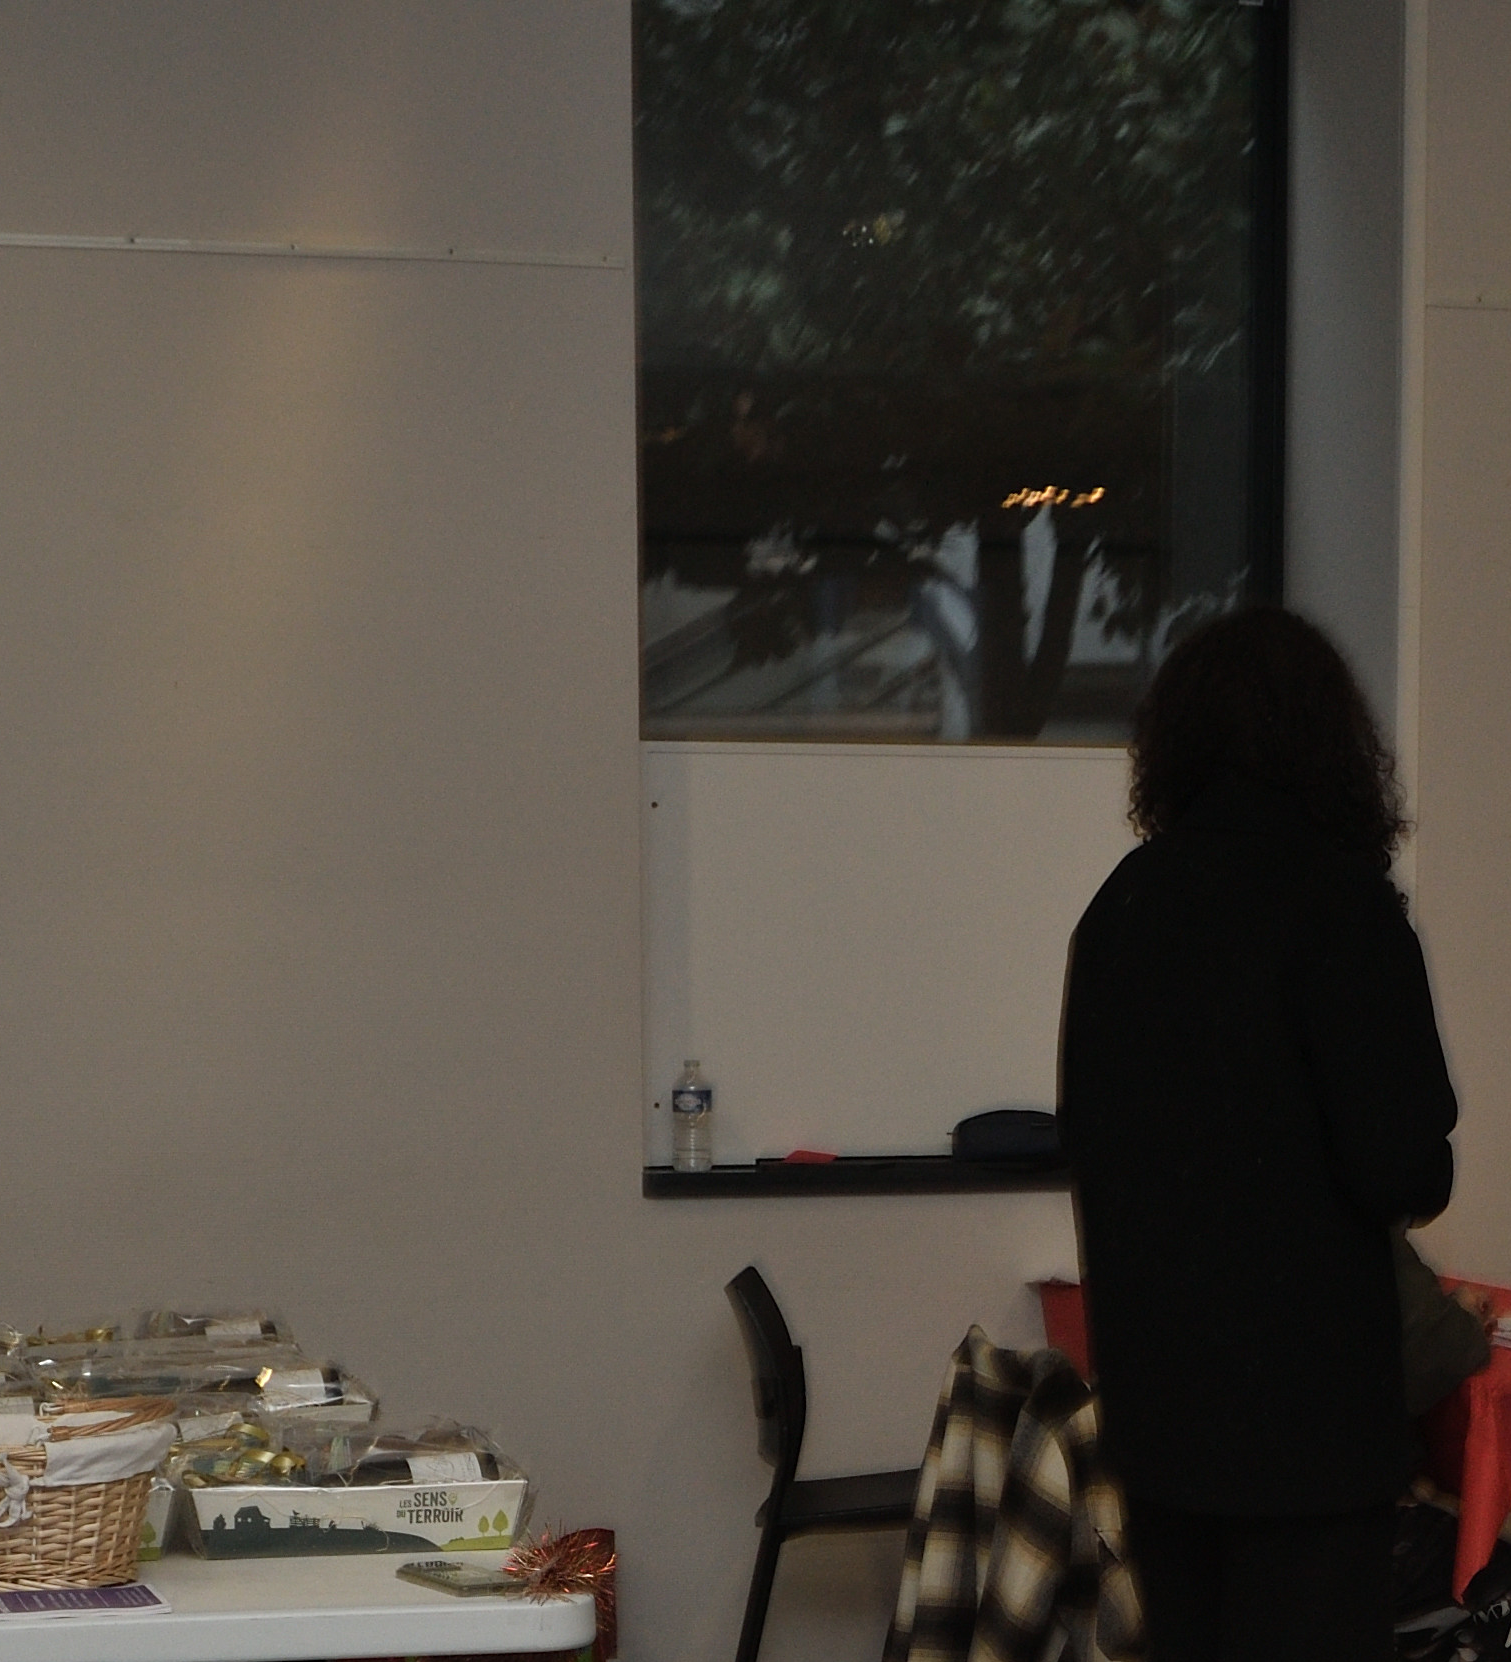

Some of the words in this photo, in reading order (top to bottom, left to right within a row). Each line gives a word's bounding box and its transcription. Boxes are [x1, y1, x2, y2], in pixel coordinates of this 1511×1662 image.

[400, 1500, 411, 1508] LES
[414, 1491, 447, 1507] SENS
[397, 1510, 406, 1518] DU
[407, 1508, 463, 1524] TERROIR
